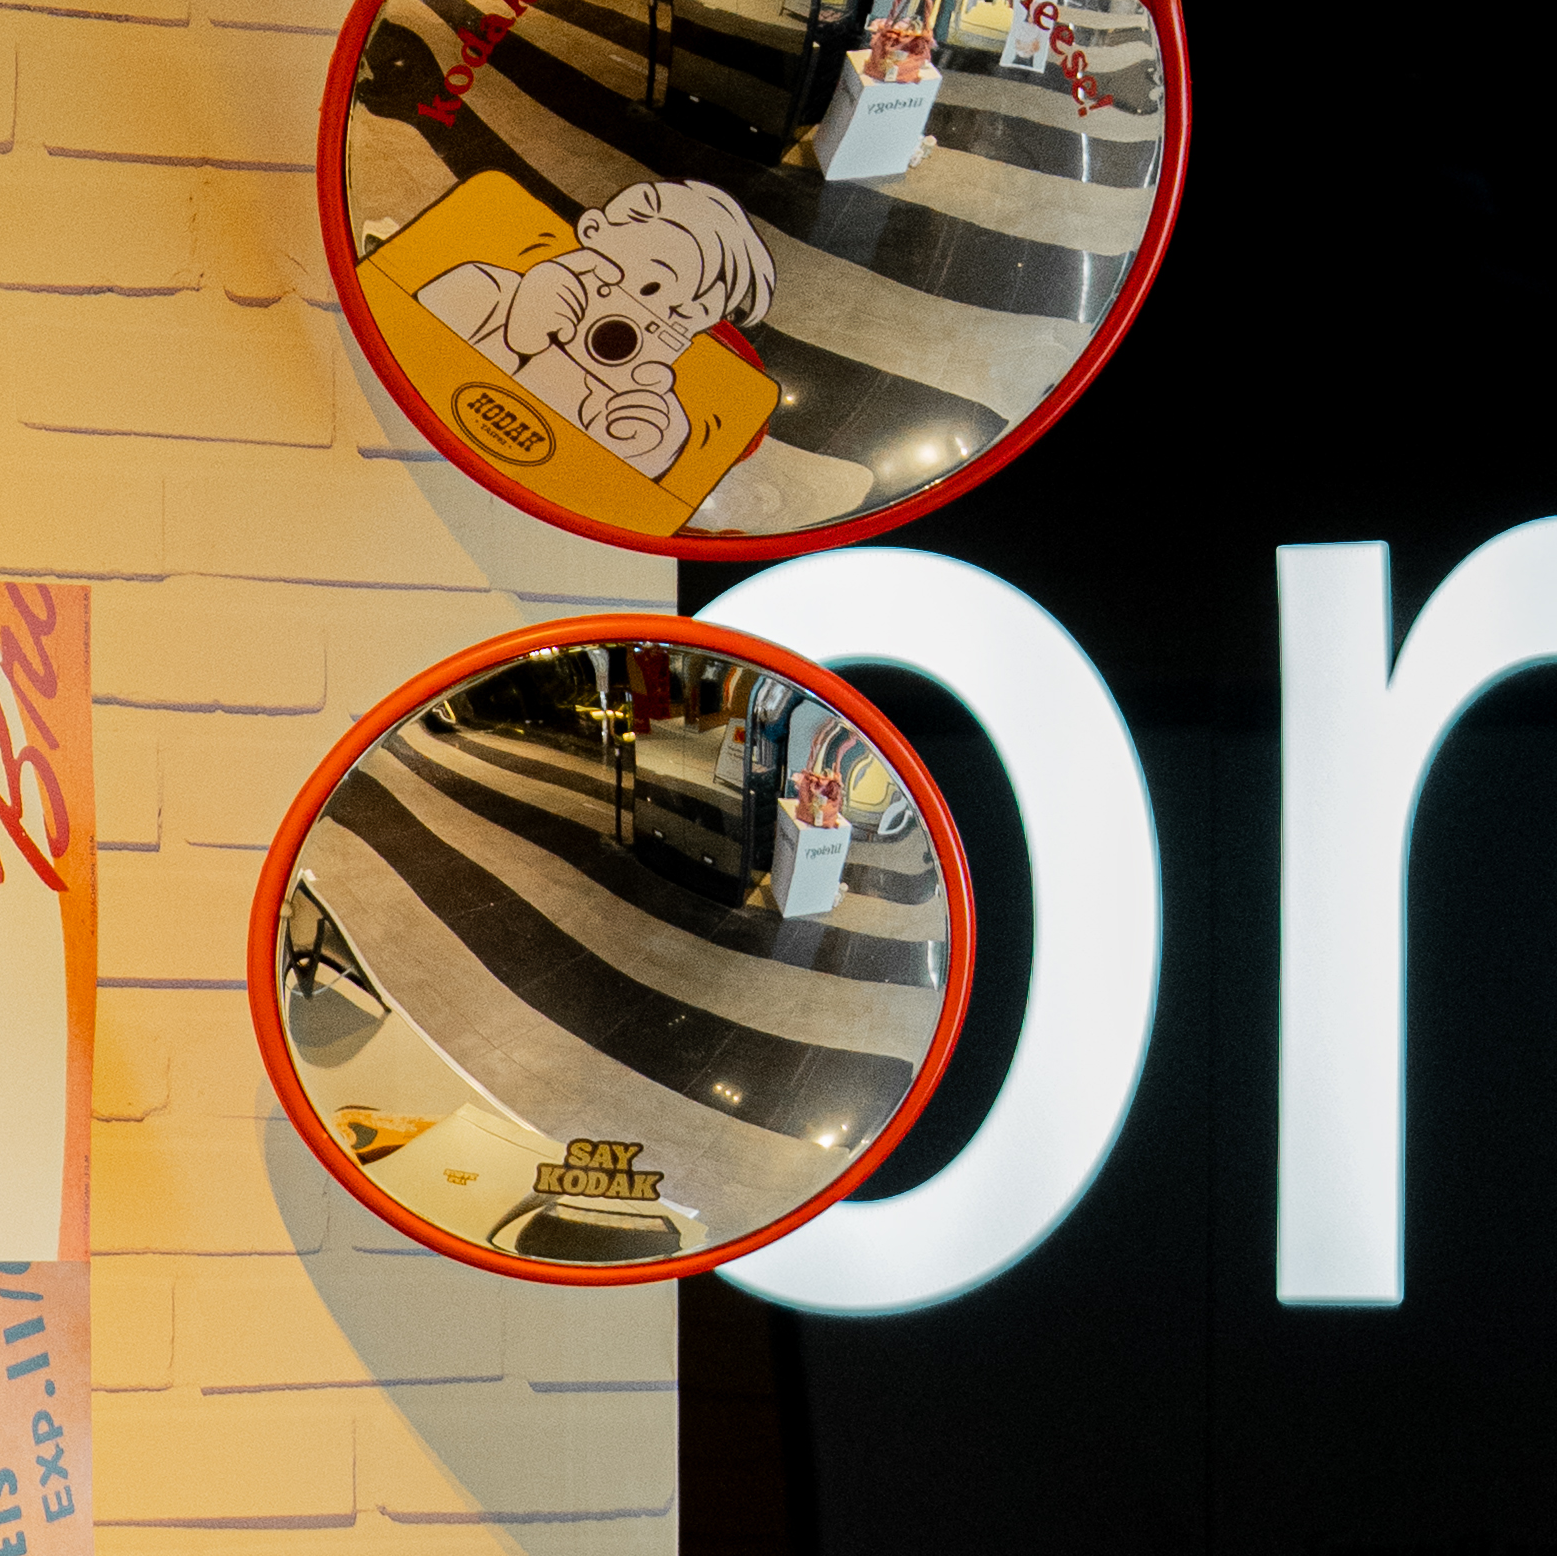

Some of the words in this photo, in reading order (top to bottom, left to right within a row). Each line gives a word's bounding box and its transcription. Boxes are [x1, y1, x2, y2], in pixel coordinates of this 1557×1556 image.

[467, 392, 546, 452] KODAK
[567, 1141, 640, 1171] SAY
[537, 1164, 661, 1199] KODAK
